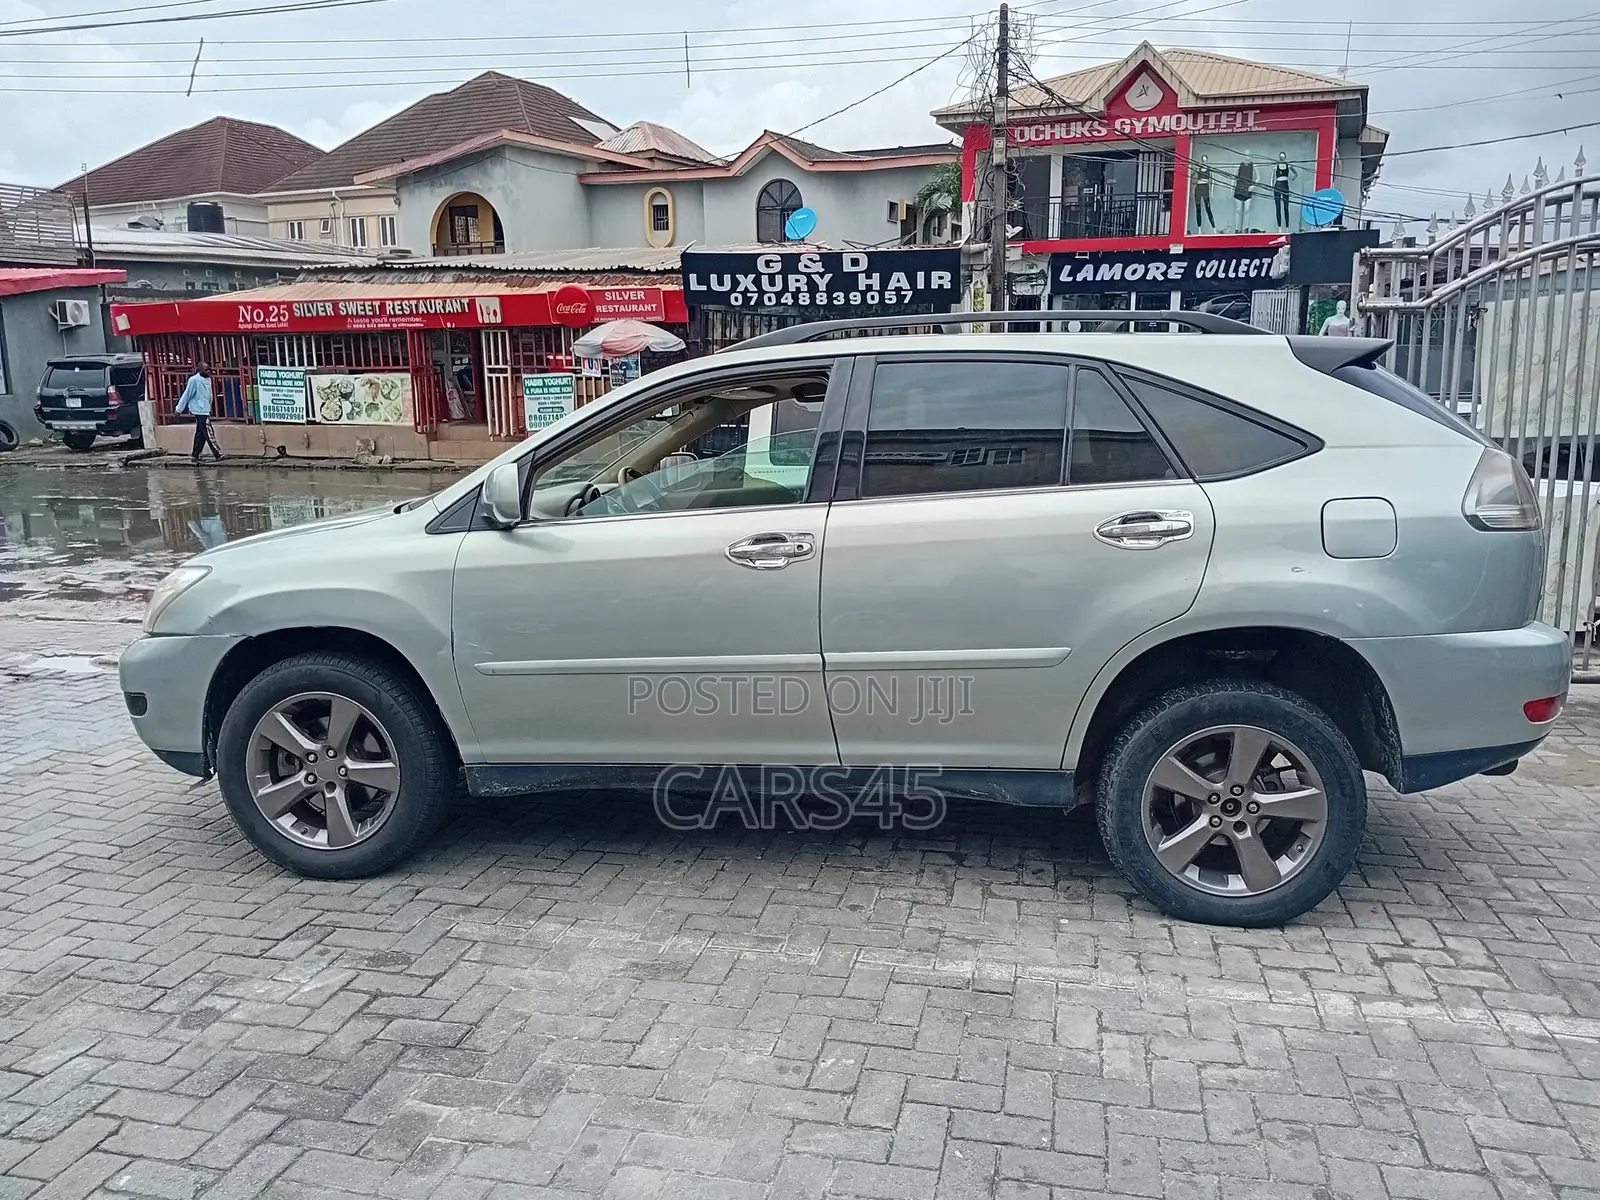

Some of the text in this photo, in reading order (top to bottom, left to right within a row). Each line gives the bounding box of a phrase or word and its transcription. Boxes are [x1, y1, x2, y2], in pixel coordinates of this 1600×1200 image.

[1014, 109, 1261, 143] OCHUKS GYMOUTFIT
[1233, 125, 1250, 133] Sport
[756, 252, 869, 274] G & D
[1058, 261, 1188, 282] LAMORE
[688, 270, 952, 293] LUXURY HAIR
[604, 290, 646, 301] SILVER
[729, 289, 914, 307] 07048839057
[237, 297, 470, 323] No.25 SILVER SWEET RESTAURANT
[595, 303, 658, 313] RESTAURANT
[260, 370, 304, 379] HABIB YOGHURT
[525, 377, 573, 387] HABIB YOGHURT
